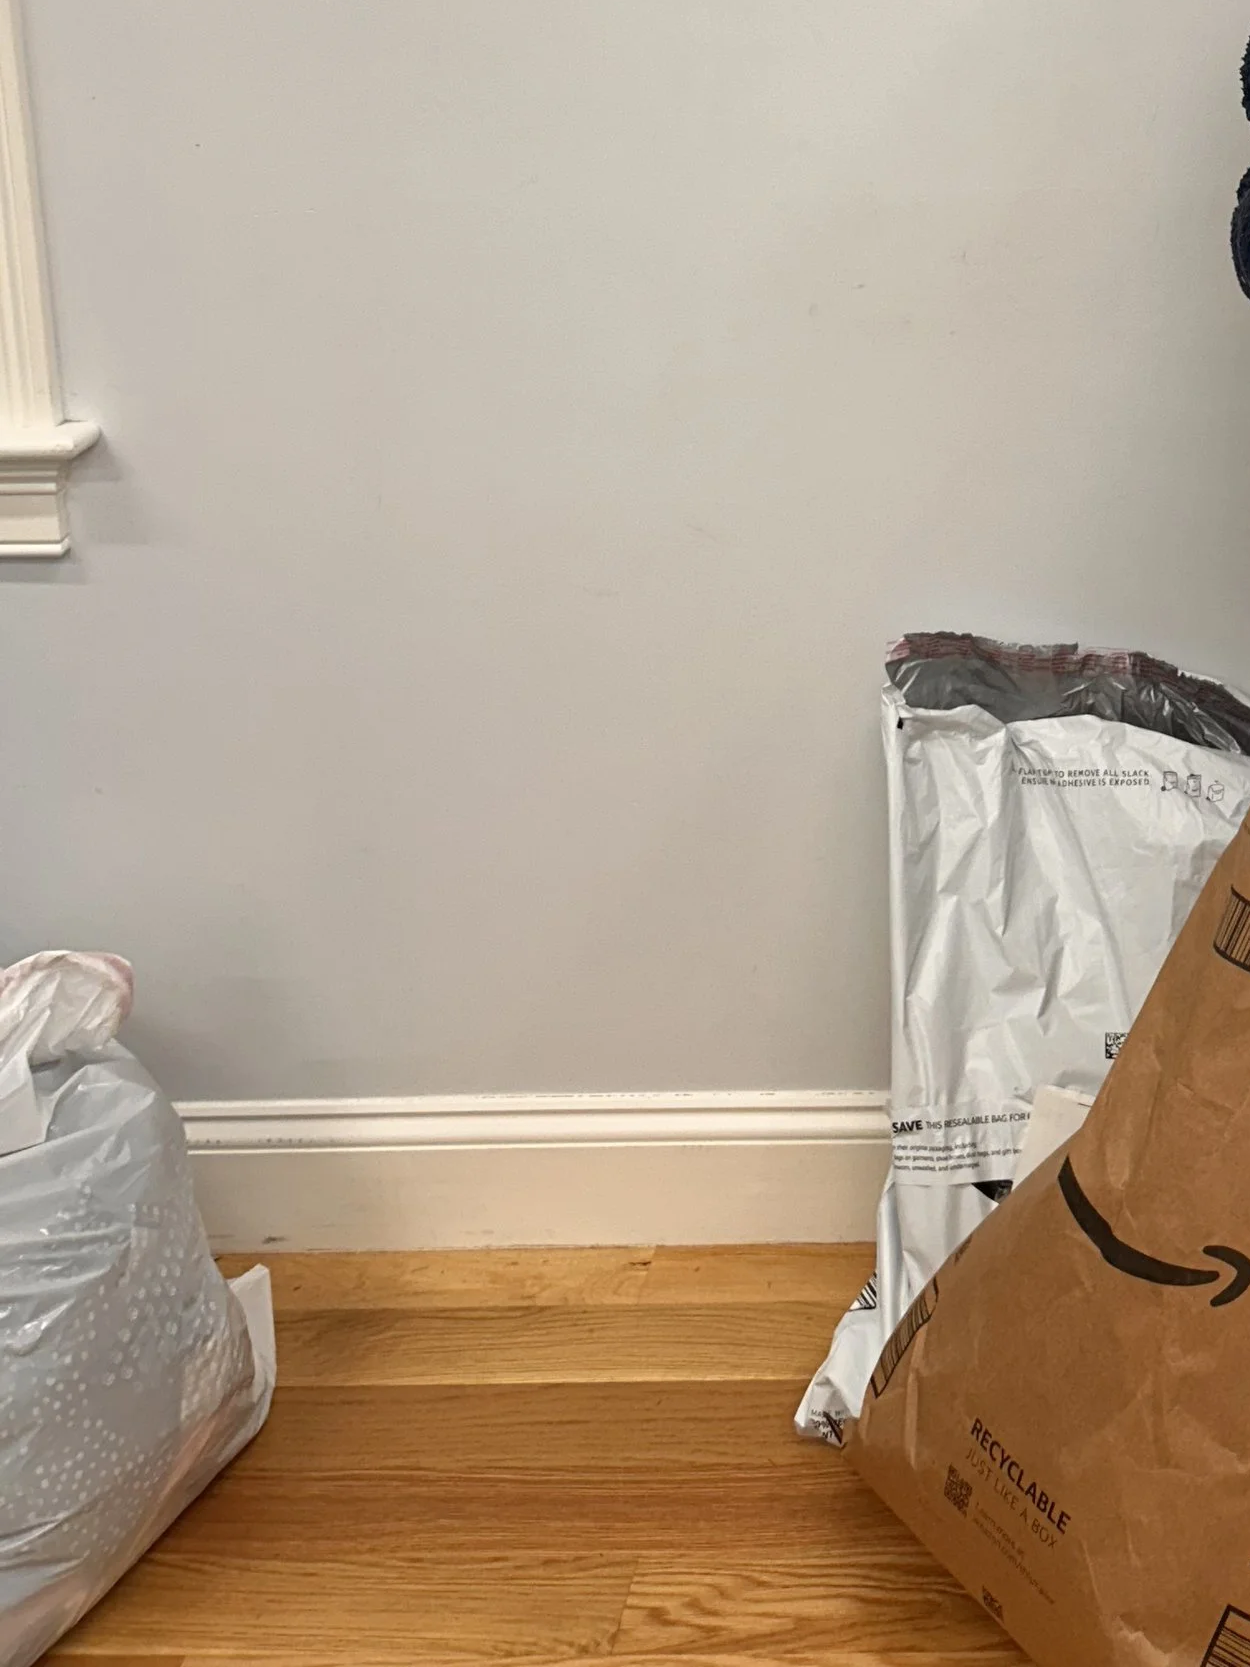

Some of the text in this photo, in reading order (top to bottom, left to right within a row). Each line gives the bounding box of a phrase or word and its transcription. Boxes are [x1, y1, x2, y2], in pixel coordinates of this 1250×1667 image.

[1067, 769, 1100, 778] REMOVE
[1103, 769, 1118, 777] ALL
[1121, 769, 1150, 778] SLACK
[1099, 778, 1106, 786] IS
[1108, 778, 1150, 786] EXPOSED
[892, 1120, 923, 1134] SAVE
[926, 1121, 943, 1130] THIS
[944, 1115, 990, 1128] RESEALABLE
[991, 1114, 1008, 1123] BAG
[1009, 1113, 1026, 1122] FOR
[970, 1417, 1071, 1534] RECYCLABLE
[966, 1448, 1058, 1550] JUST LIKE A BOX
